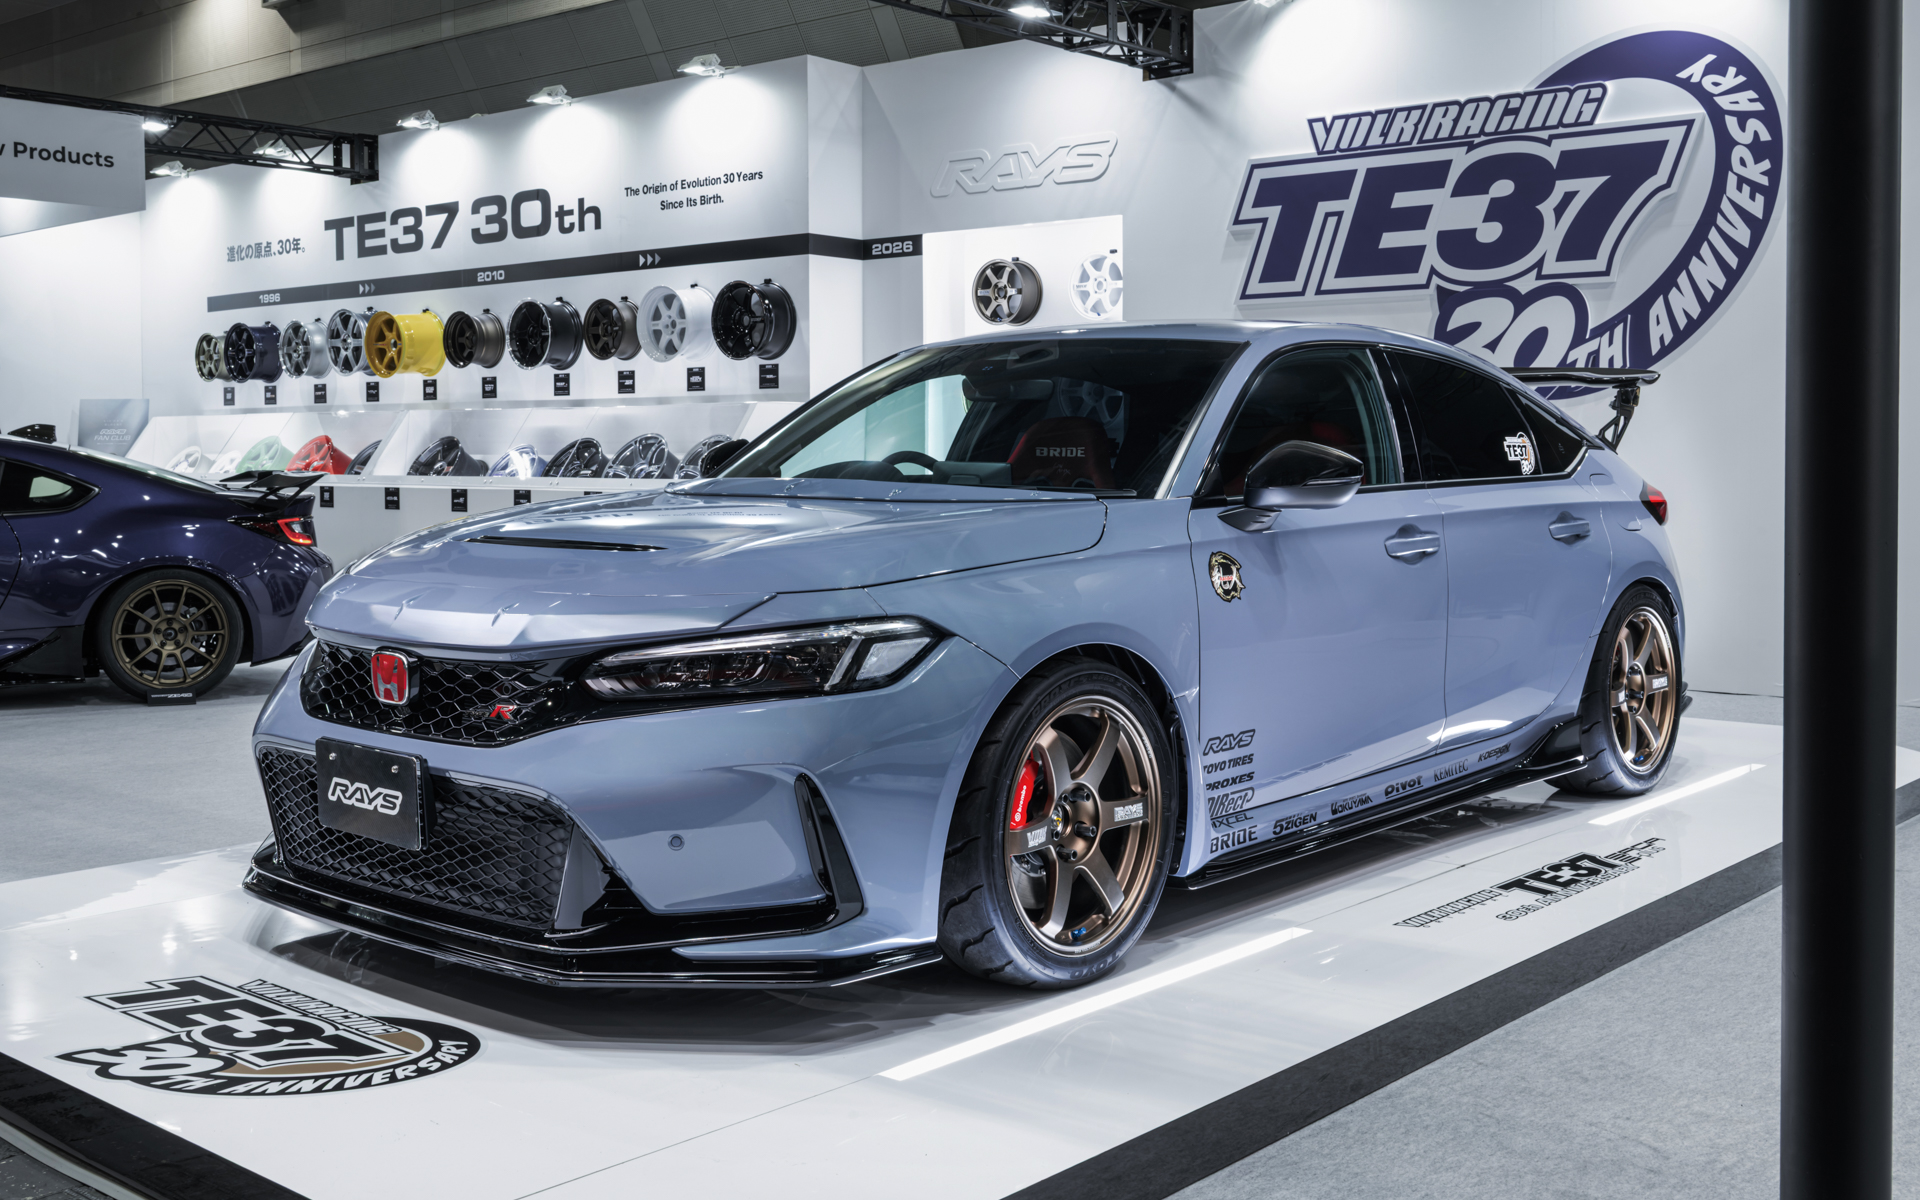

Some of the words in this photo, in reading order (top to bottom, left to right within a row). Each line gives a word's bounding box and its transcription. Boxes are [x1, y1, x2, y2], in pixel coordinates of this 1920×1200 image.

[1307, 108, 1429, 155] VOLK
[1416, 82, 1609, 144] RACING
[13, 141, 115, 168] Products
[930, 131, 1118, 198] RAYS
[624, 187, 640, 198] The
[642, 182, 668, 195] Origin
[669, 180, 679, 191] of
[680, 174, 722, 190] Evolution
[723, 172, 735, 184] 30
[736, 170, 763, 183] Years
[660, 199, 684, 211] Since
[686, 196, 698, 208] Its
[699, 193, 724, 206] Birth.
[1249, 136, 1676, 286] TE37
[1649, 53, 1772, 356] ANNIVERSARY
[323, 200, 460, 262] TE37
[471, 187, 602, 245] 30th
[227, 237, 306, 262] 進化の原点、30年。
[872, 240, 913, 256] 2026
[477, 270, 505, 283] 2010
[258, 293, 281, 304] 1996
[1035, 446, 1086, 458] BRIDE
[1203, 729, 1255, 756] RAYS
[1227, 753, 1254, 770] TIRES
[1433, 758, 1469, 783] KEMITEC
[1206, 771, 1255, 791] PROXES
[327, 776, 403, 816] RAYS
[1017, 784, 1028, 813] brembo
[1272, 812, 1318, 836] 5ZIGEN
[1210, 825, 1258, 854] BRIDE
[1490, 852, 1626, 897] TE37
[92, 977, 408, 1067] TE37
[217, 1040, 469, 1094] ANNIVERSARY
